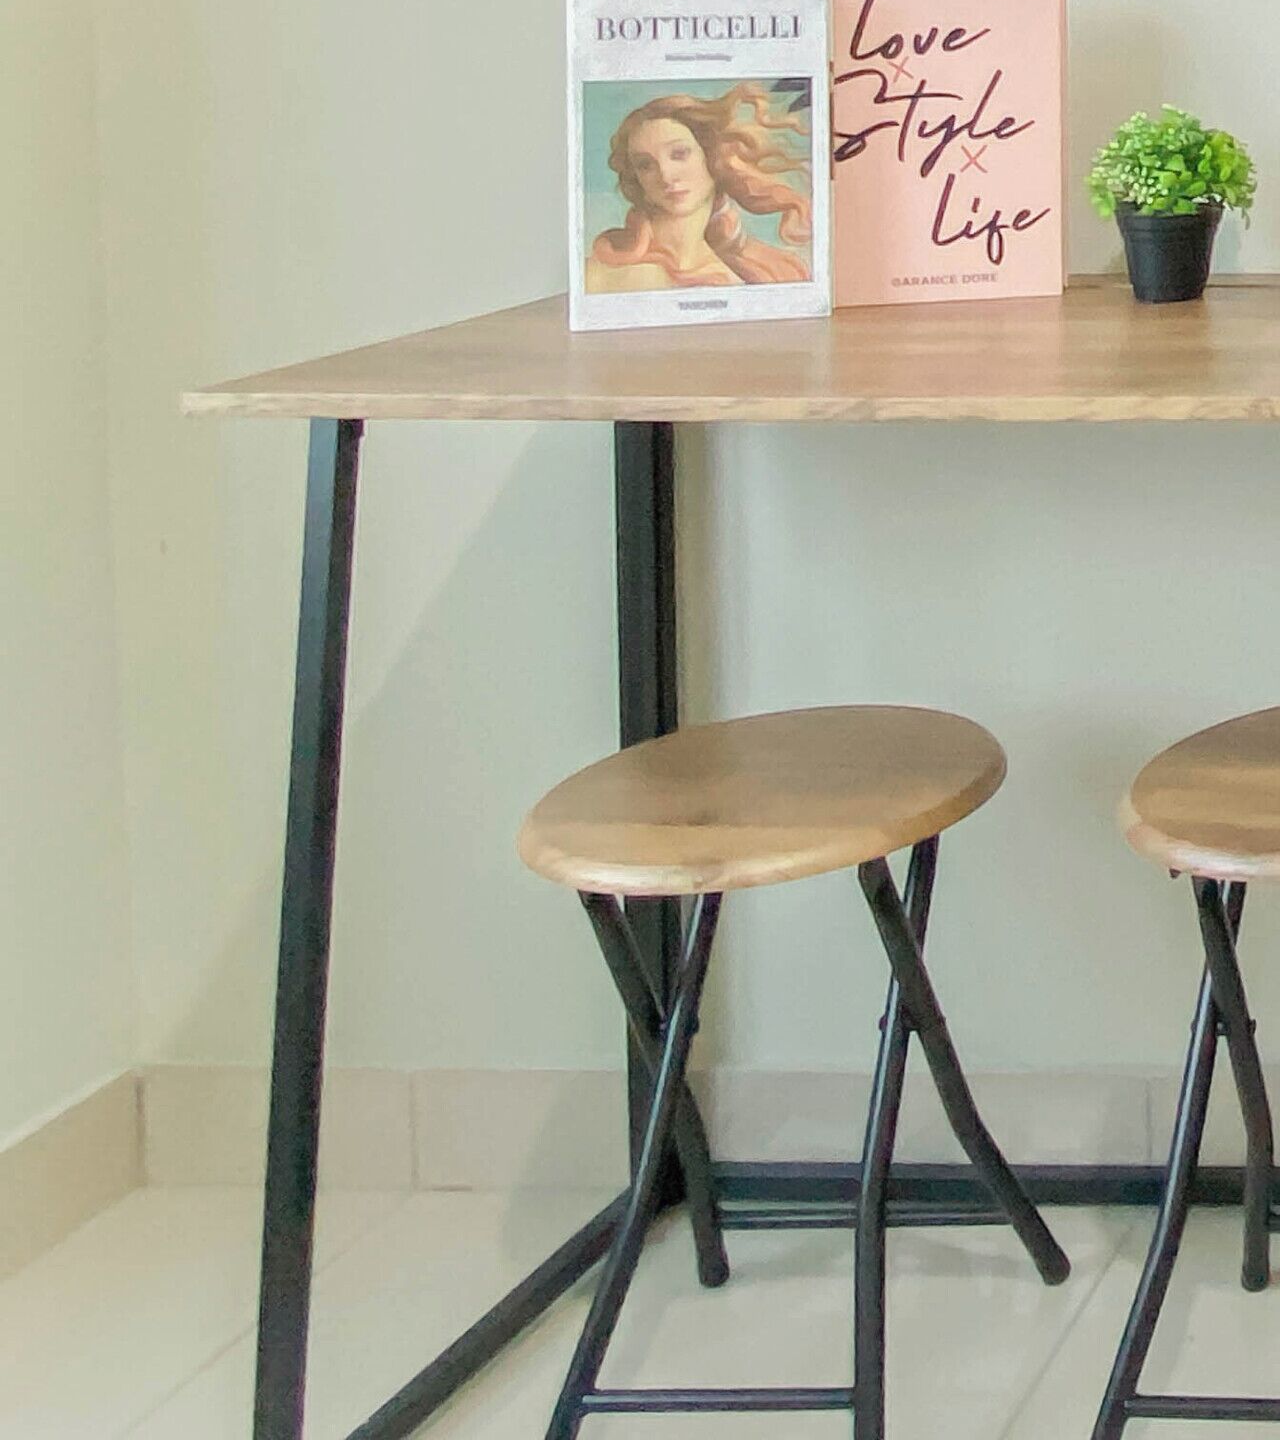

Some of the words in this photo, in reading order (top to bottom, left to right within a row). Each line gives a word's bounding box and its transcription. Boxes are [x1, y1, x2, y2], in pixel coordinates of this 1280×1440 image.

[596, 15, 801, 41] BOTTICELLI
[834, 69, 1035, 178] Style
[931, 173, 1051, 266] Life
